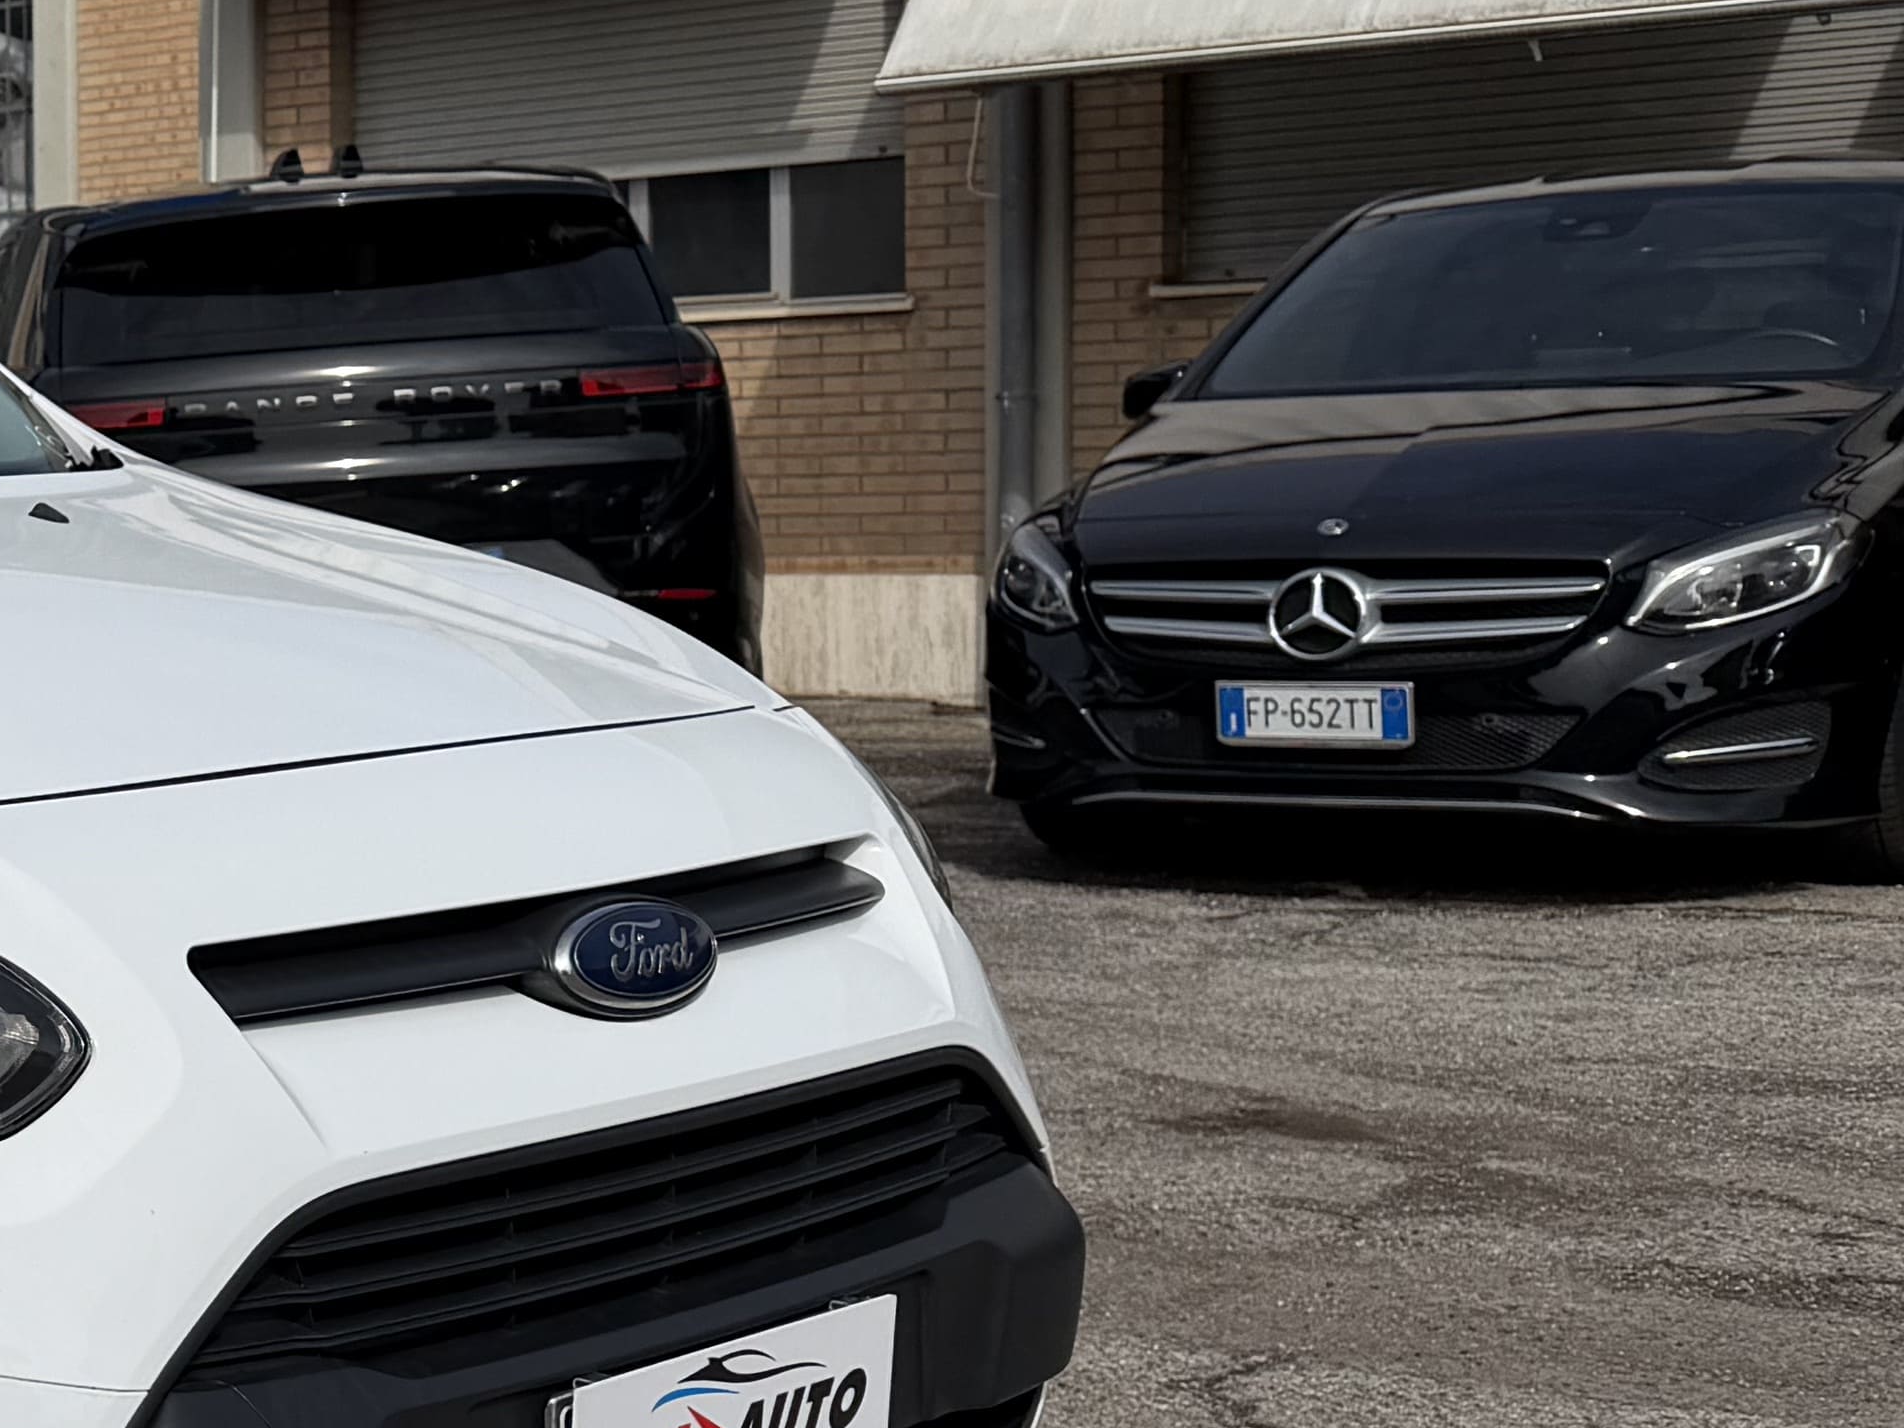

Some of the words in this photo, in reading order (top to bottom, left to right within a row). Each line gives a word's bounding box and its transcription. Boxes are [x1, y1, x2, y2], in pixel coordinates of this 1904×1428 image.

[184, 390, 354, 416] RANGE
[393, 378, 565, 404] ROVER
[609, 917, 694, 983] Ford
